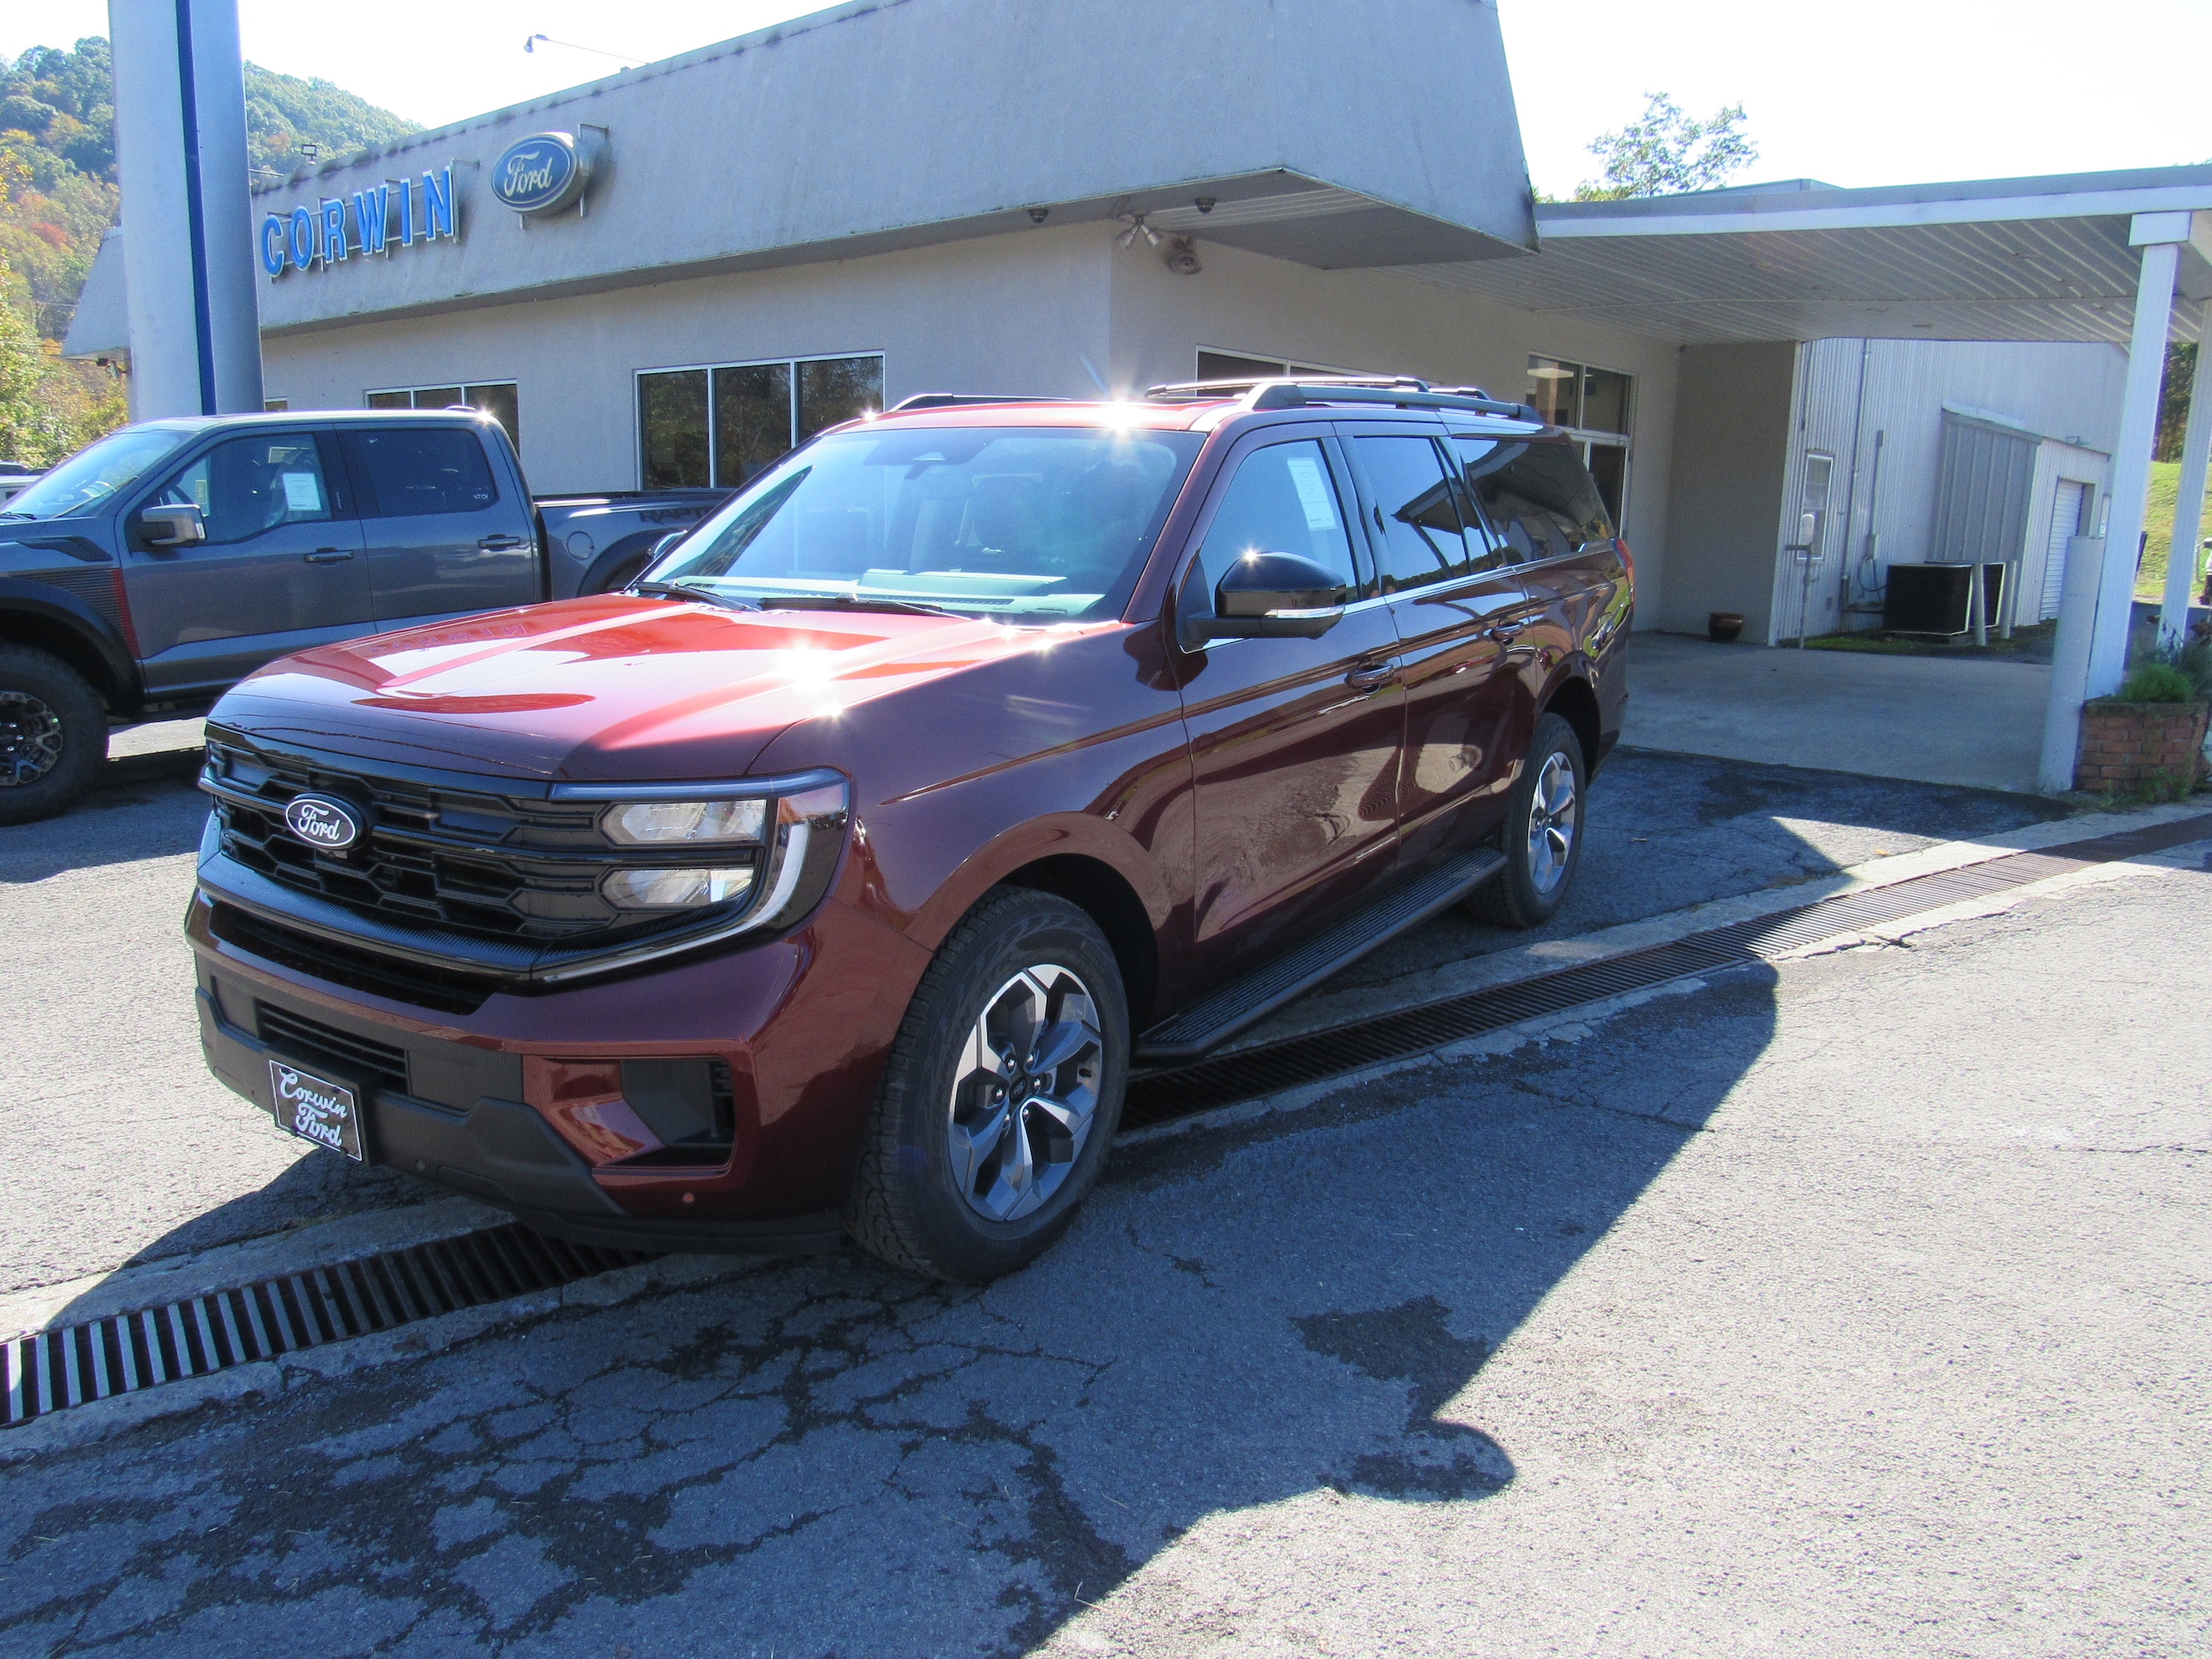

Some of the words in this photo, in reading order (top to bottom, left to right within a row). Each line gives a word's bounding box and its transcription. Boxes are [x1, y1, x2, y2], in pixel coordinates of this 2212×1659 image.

[503, 150, 553, 197] Ford
[261, 165, 455, 278] CORWIN
[639, 507, 713, 526] RAPT
[298, 804, 341, 841] Ford
[279, 1068, 348, 1118] Corwin
[296, 1102, 342, 1147] Ford
